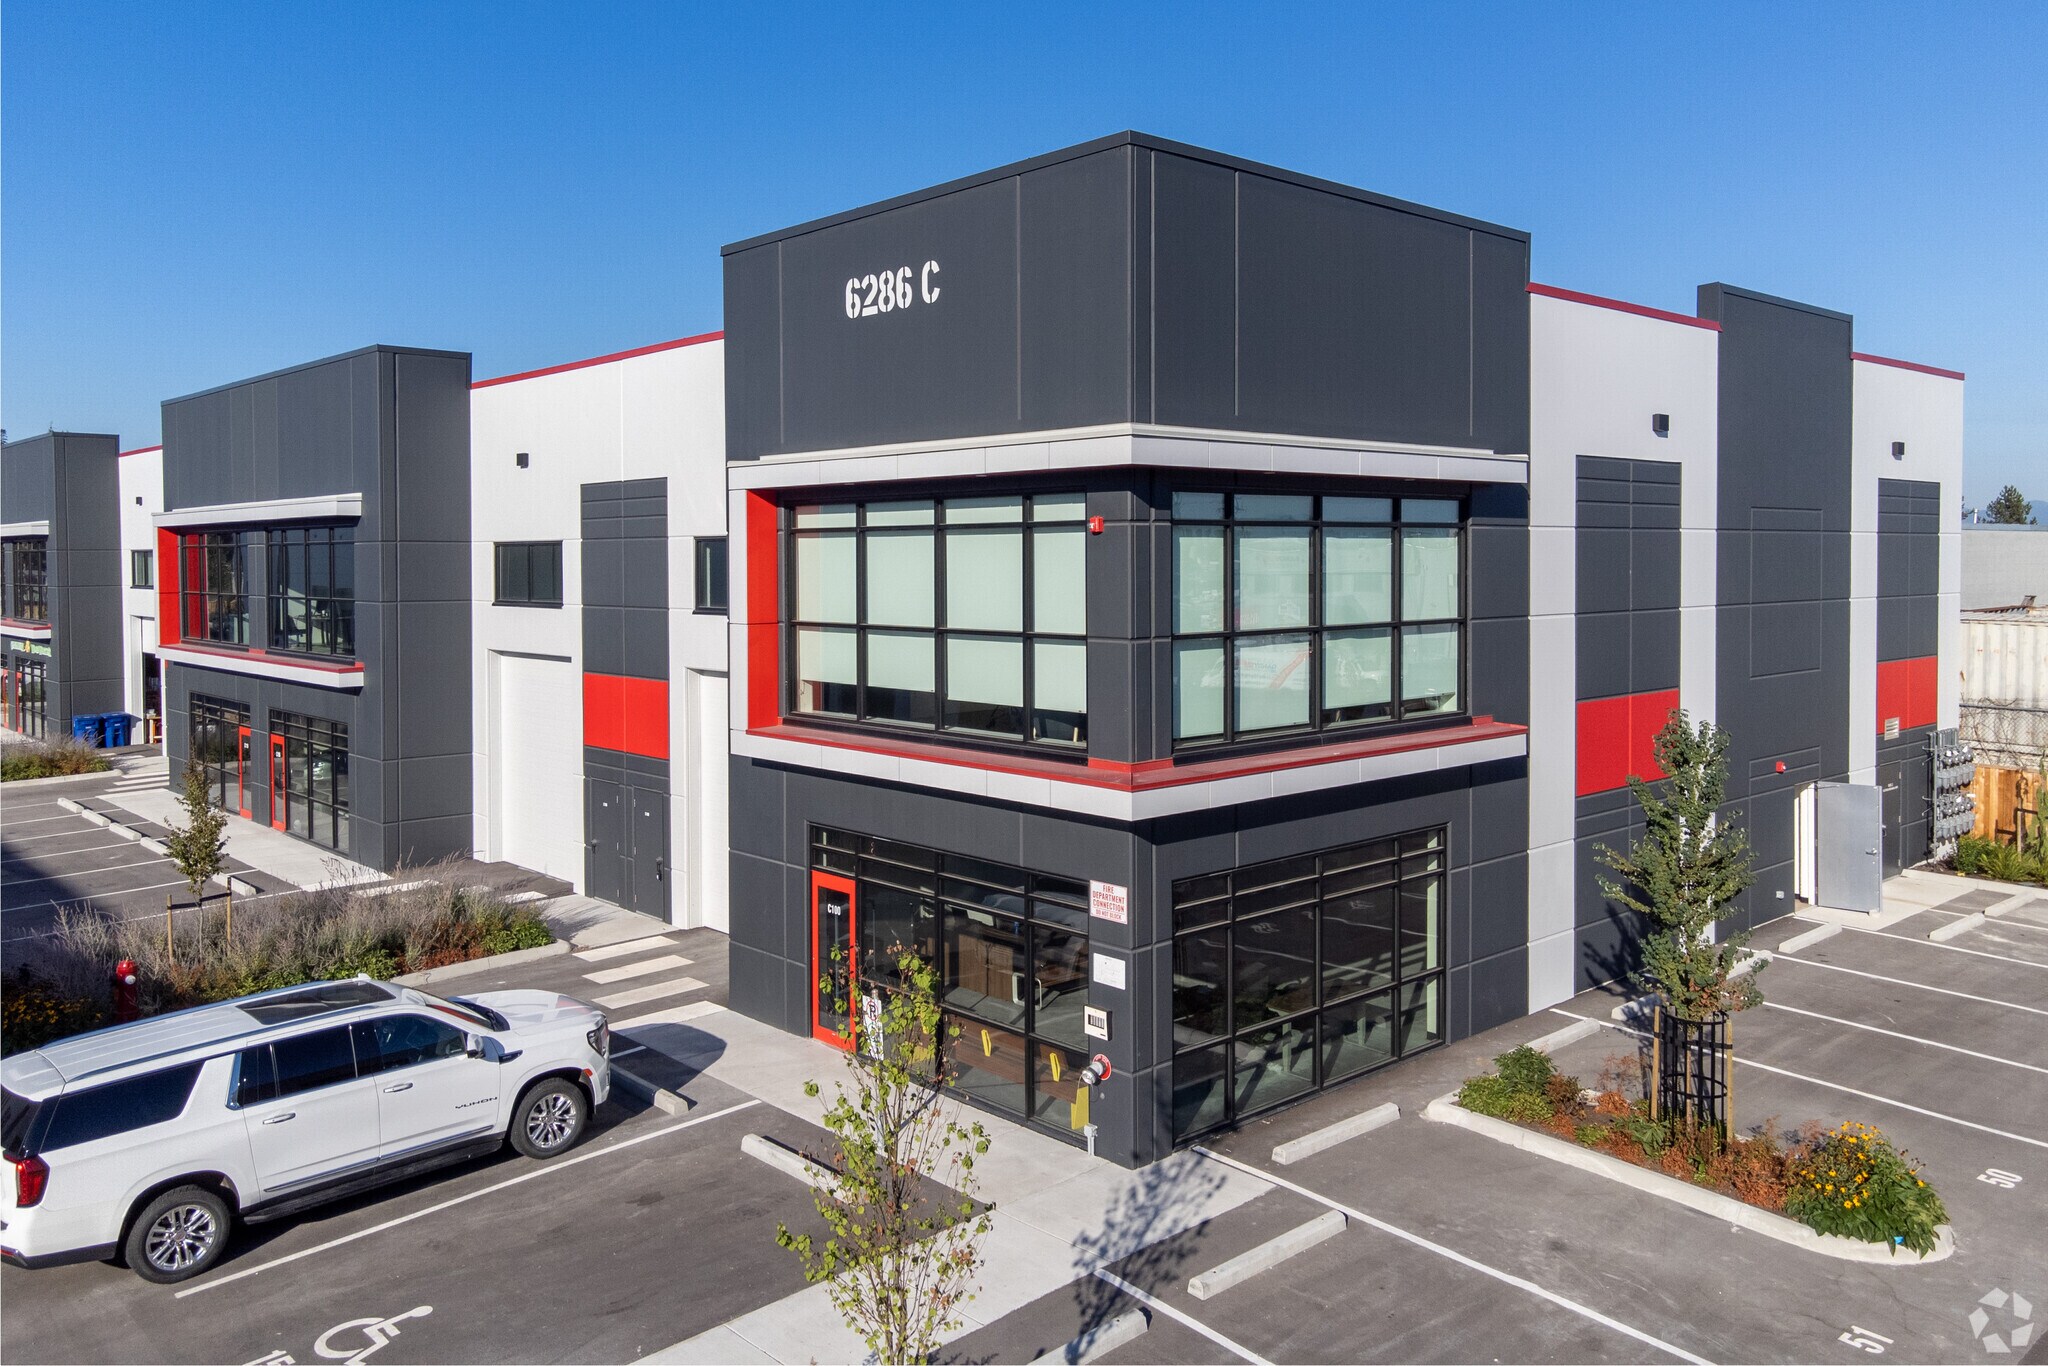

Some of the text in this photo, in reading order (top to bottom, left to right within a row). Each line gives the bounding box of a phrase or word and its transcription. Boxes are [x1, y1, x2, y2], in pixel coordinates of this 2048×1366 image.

[845, 260, 941, 319] 6286 C
[1102, 884, 1114, 894] FIRE
[1092, 890, 1125, 905] DEPARTMENT
[827, 903, 841, 916] C100
[1092, 899, 1125, 913] CONNECTION
[455, 1096, 498, 1109] YUKON
[1976, 1168, 2022, 1189] 50
[1837, 1325, 1895, 1354] 51
